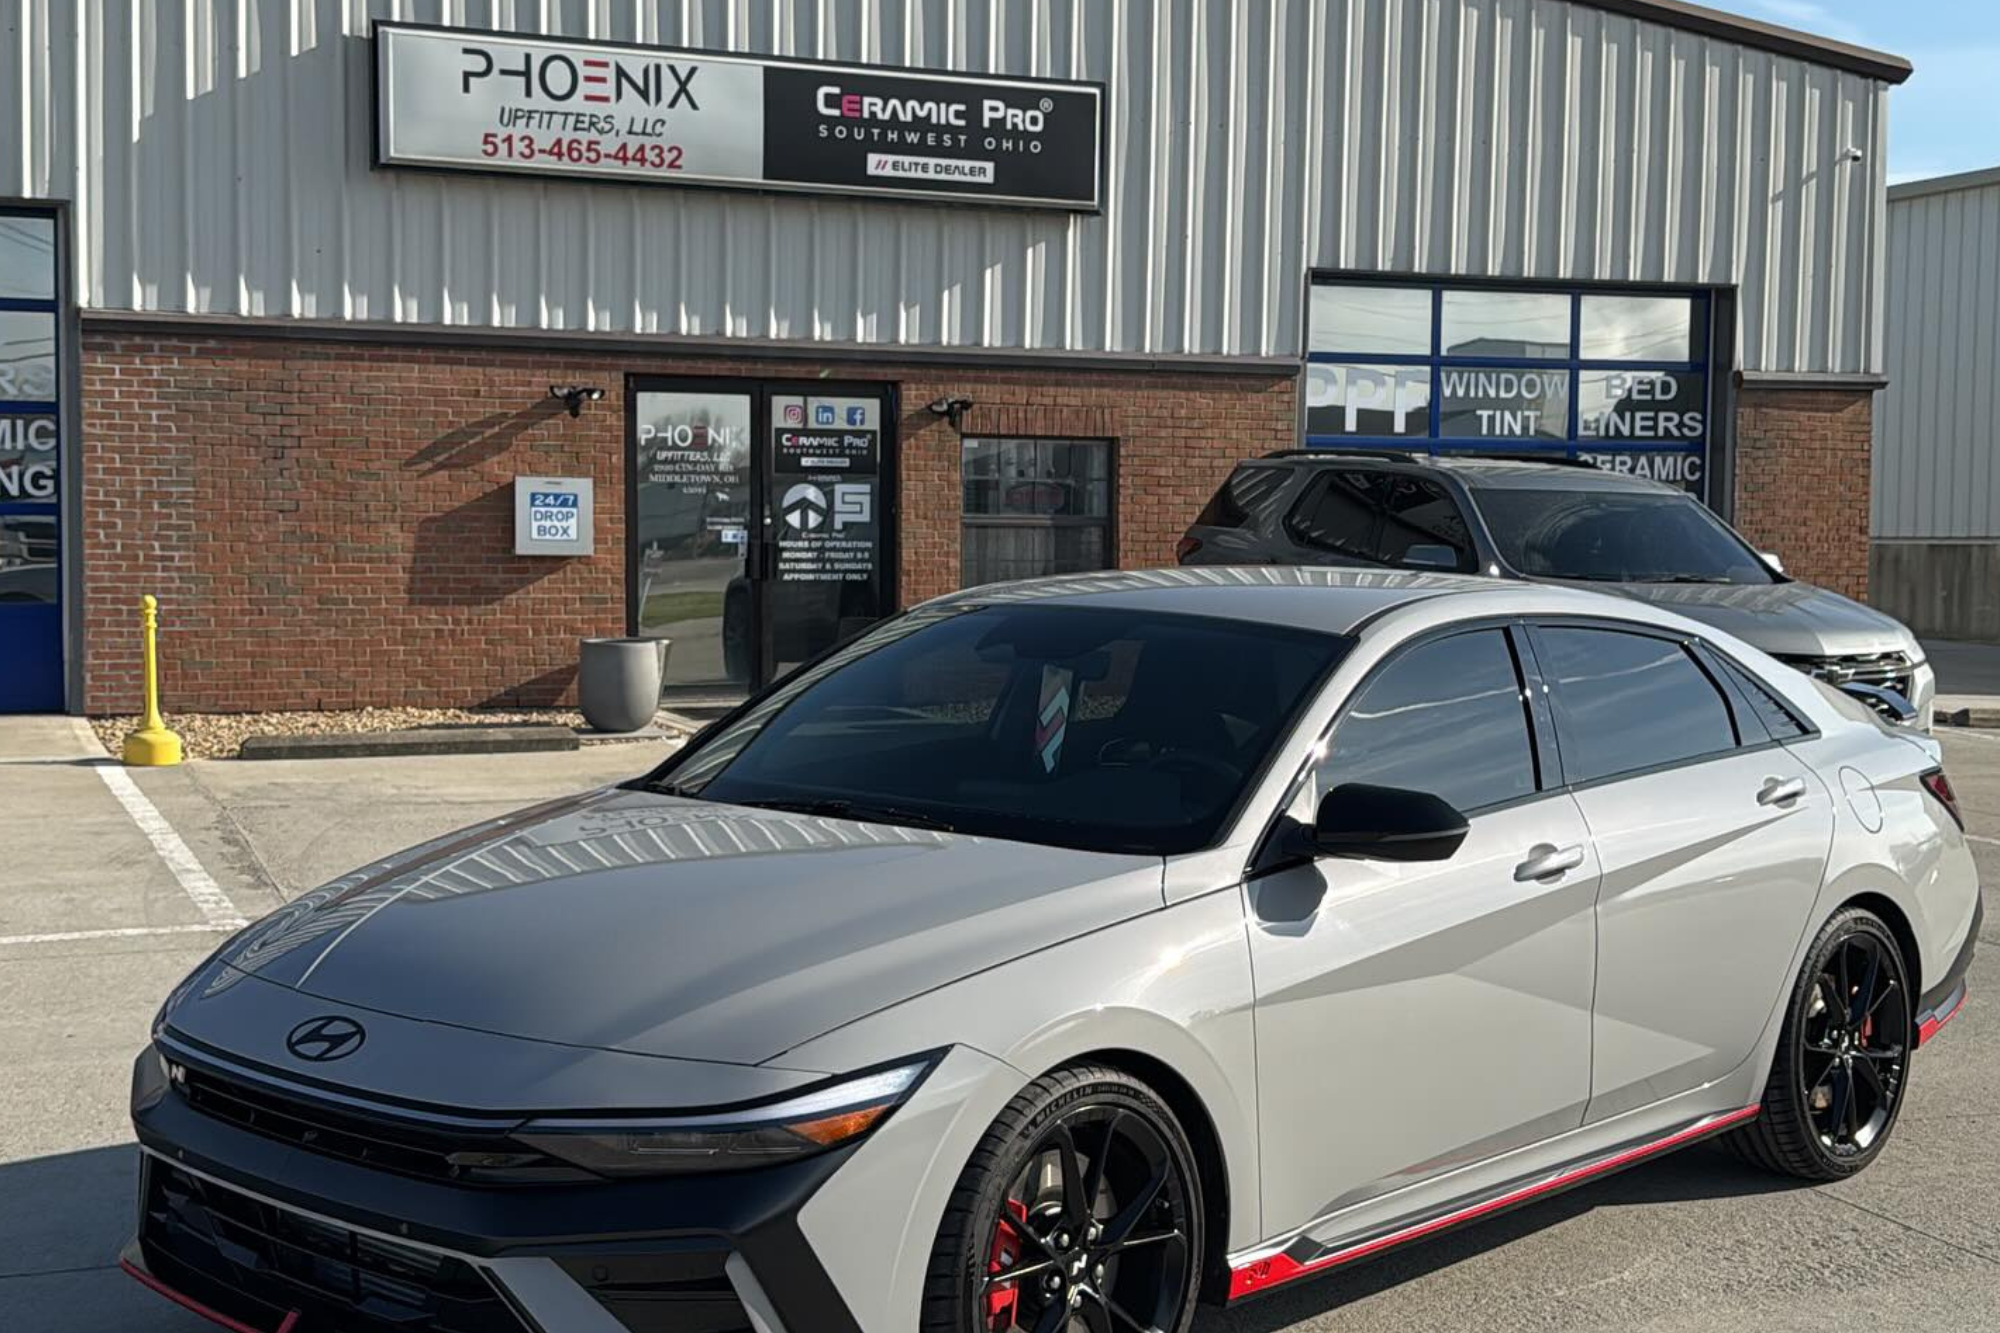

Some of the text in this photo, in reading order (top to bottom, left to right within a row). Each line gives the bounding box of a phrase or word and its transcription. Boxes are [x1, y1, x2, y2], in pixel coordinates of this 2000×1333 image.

[461, 47, 700, 111] PHOENIX
[499, 105, 667, 138] UPFITTERS, LLC
[481, 132, 684, 170] 513-465-4432
[818, 124, 1042, 154] SOUTHWEST OHIO
[891, 160, 988, 178] ELITE DEALER
[1440, 371, 1568, 399] WINDOW
[1605, 374, 1678, 401] BED
[1475, 409, 1541, 436] TINT
[1578, 411, 1704, 437] LINERS
[534, 494, 575, 506] 24/7
[533, 510, 575, 523] DROP
[537, 525, 571, 538] BOX
[845, 573, 868, 581] ONLY
